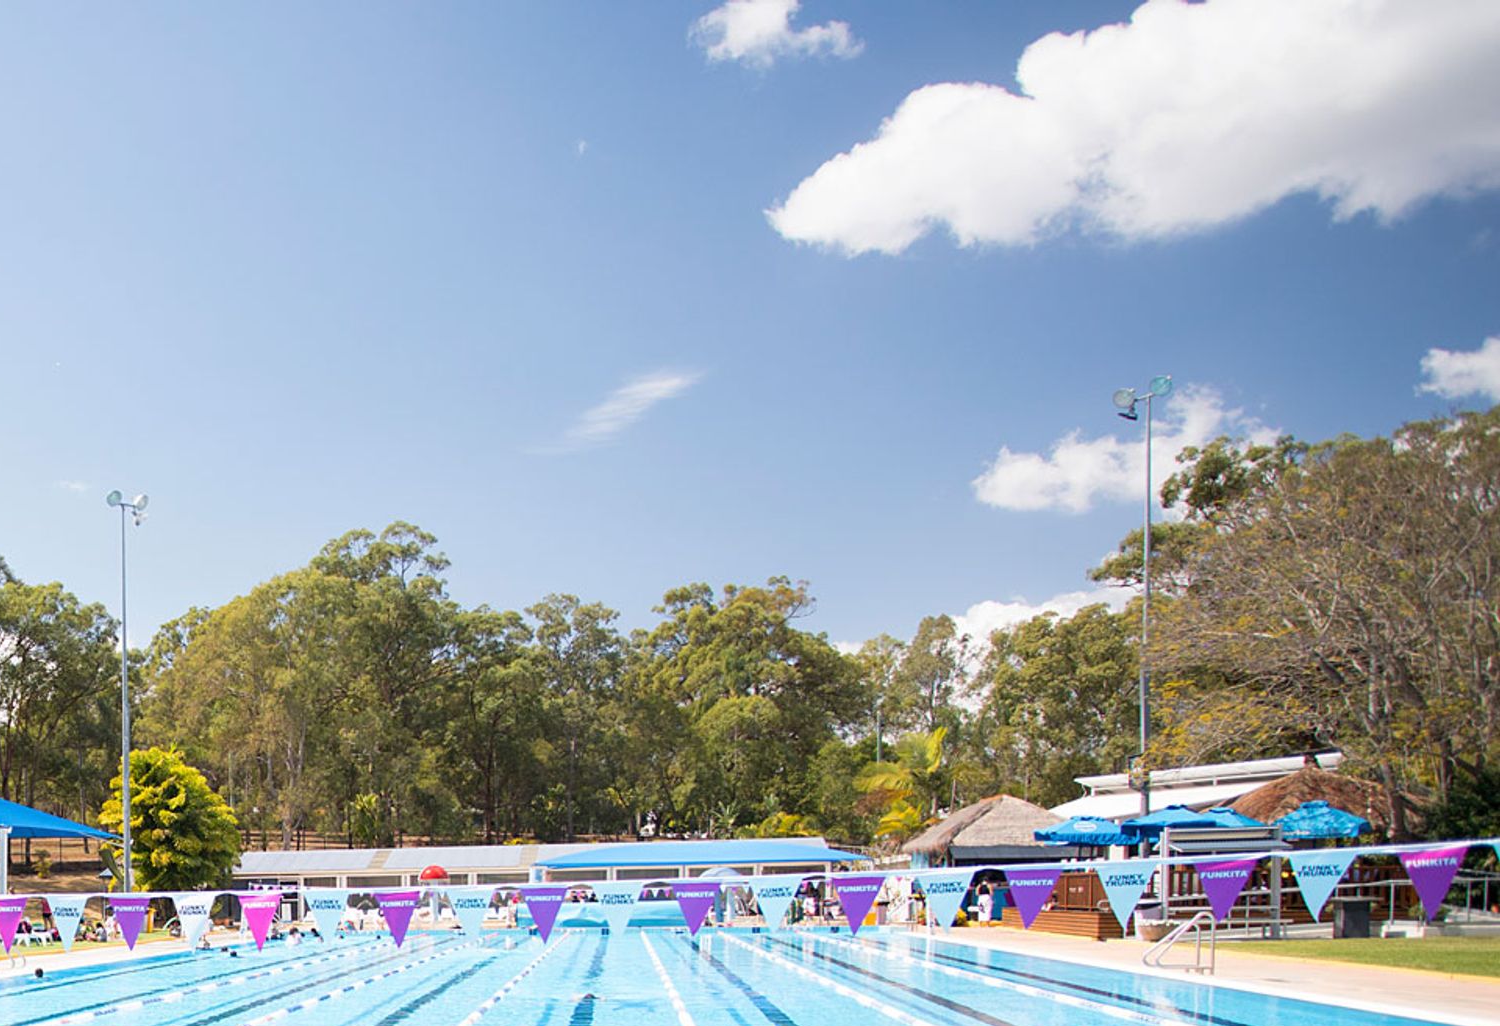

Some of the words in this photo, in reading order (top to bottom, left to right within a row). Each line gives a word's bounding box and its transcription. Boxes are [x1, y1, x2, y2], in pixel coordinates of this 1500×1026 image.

[1405, 857, 1458, 868] FUNKITA
[1301, 864, 1341, 872] FUNKY
[1200, 870, 1249, 879] FUNKITA
[1298, 870, 1343, 878] TRUNKS
[1009, 879, 1054, 887] FUNKITA
[837, 885, 878, 893] FUNKITA
